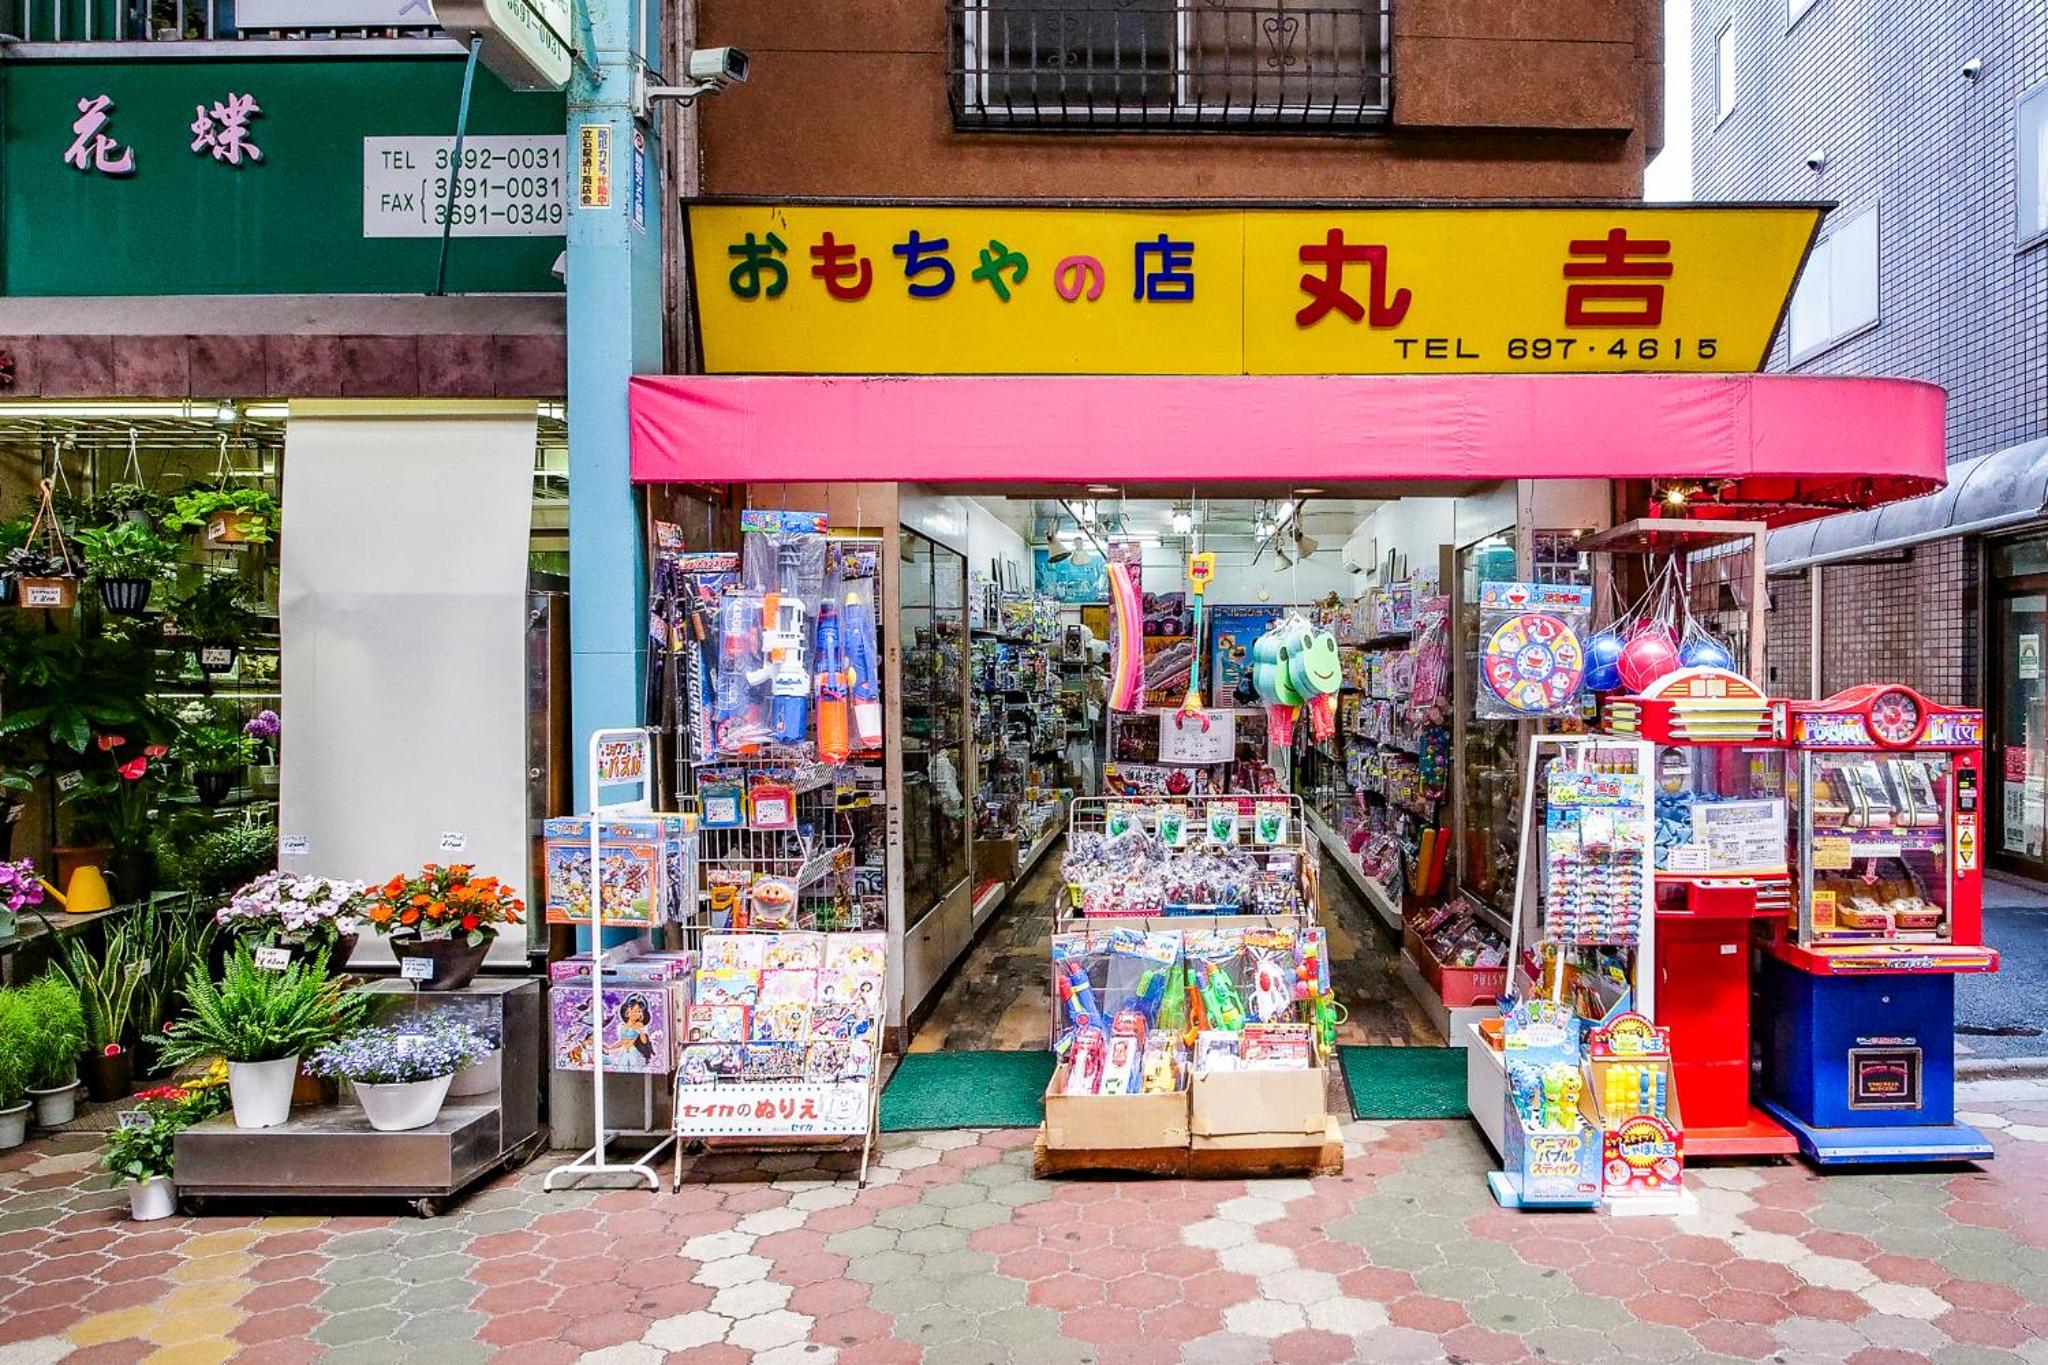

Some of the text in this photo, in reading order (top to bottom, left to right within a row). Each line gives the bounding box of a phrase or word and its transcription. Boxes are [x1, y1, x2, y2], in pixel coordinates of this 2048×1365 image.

[381, 148, 560, 169] TEL 3692-0031
[434, 177, 560, 198] 3691-0031
[381, 193, 563, 225] FAX 3691-0349
[728, 227, 1674, 328] おもちゃの店 丸吉
[1393, 338, 1479, 360] TEL
[606, 755, 641, 778] パズル
[1610, 1036, 1662, 1052] しん玉
[683, 1098, 818, 1119] セイカのぬりえ
[791, 1123, 813, 1132] セイカ
[1534, 1137, 1579, 1149] アニマル
[1539, 1151, 1572, 1163] バブル
[1531, 1164, 1579, 1175] スティック
